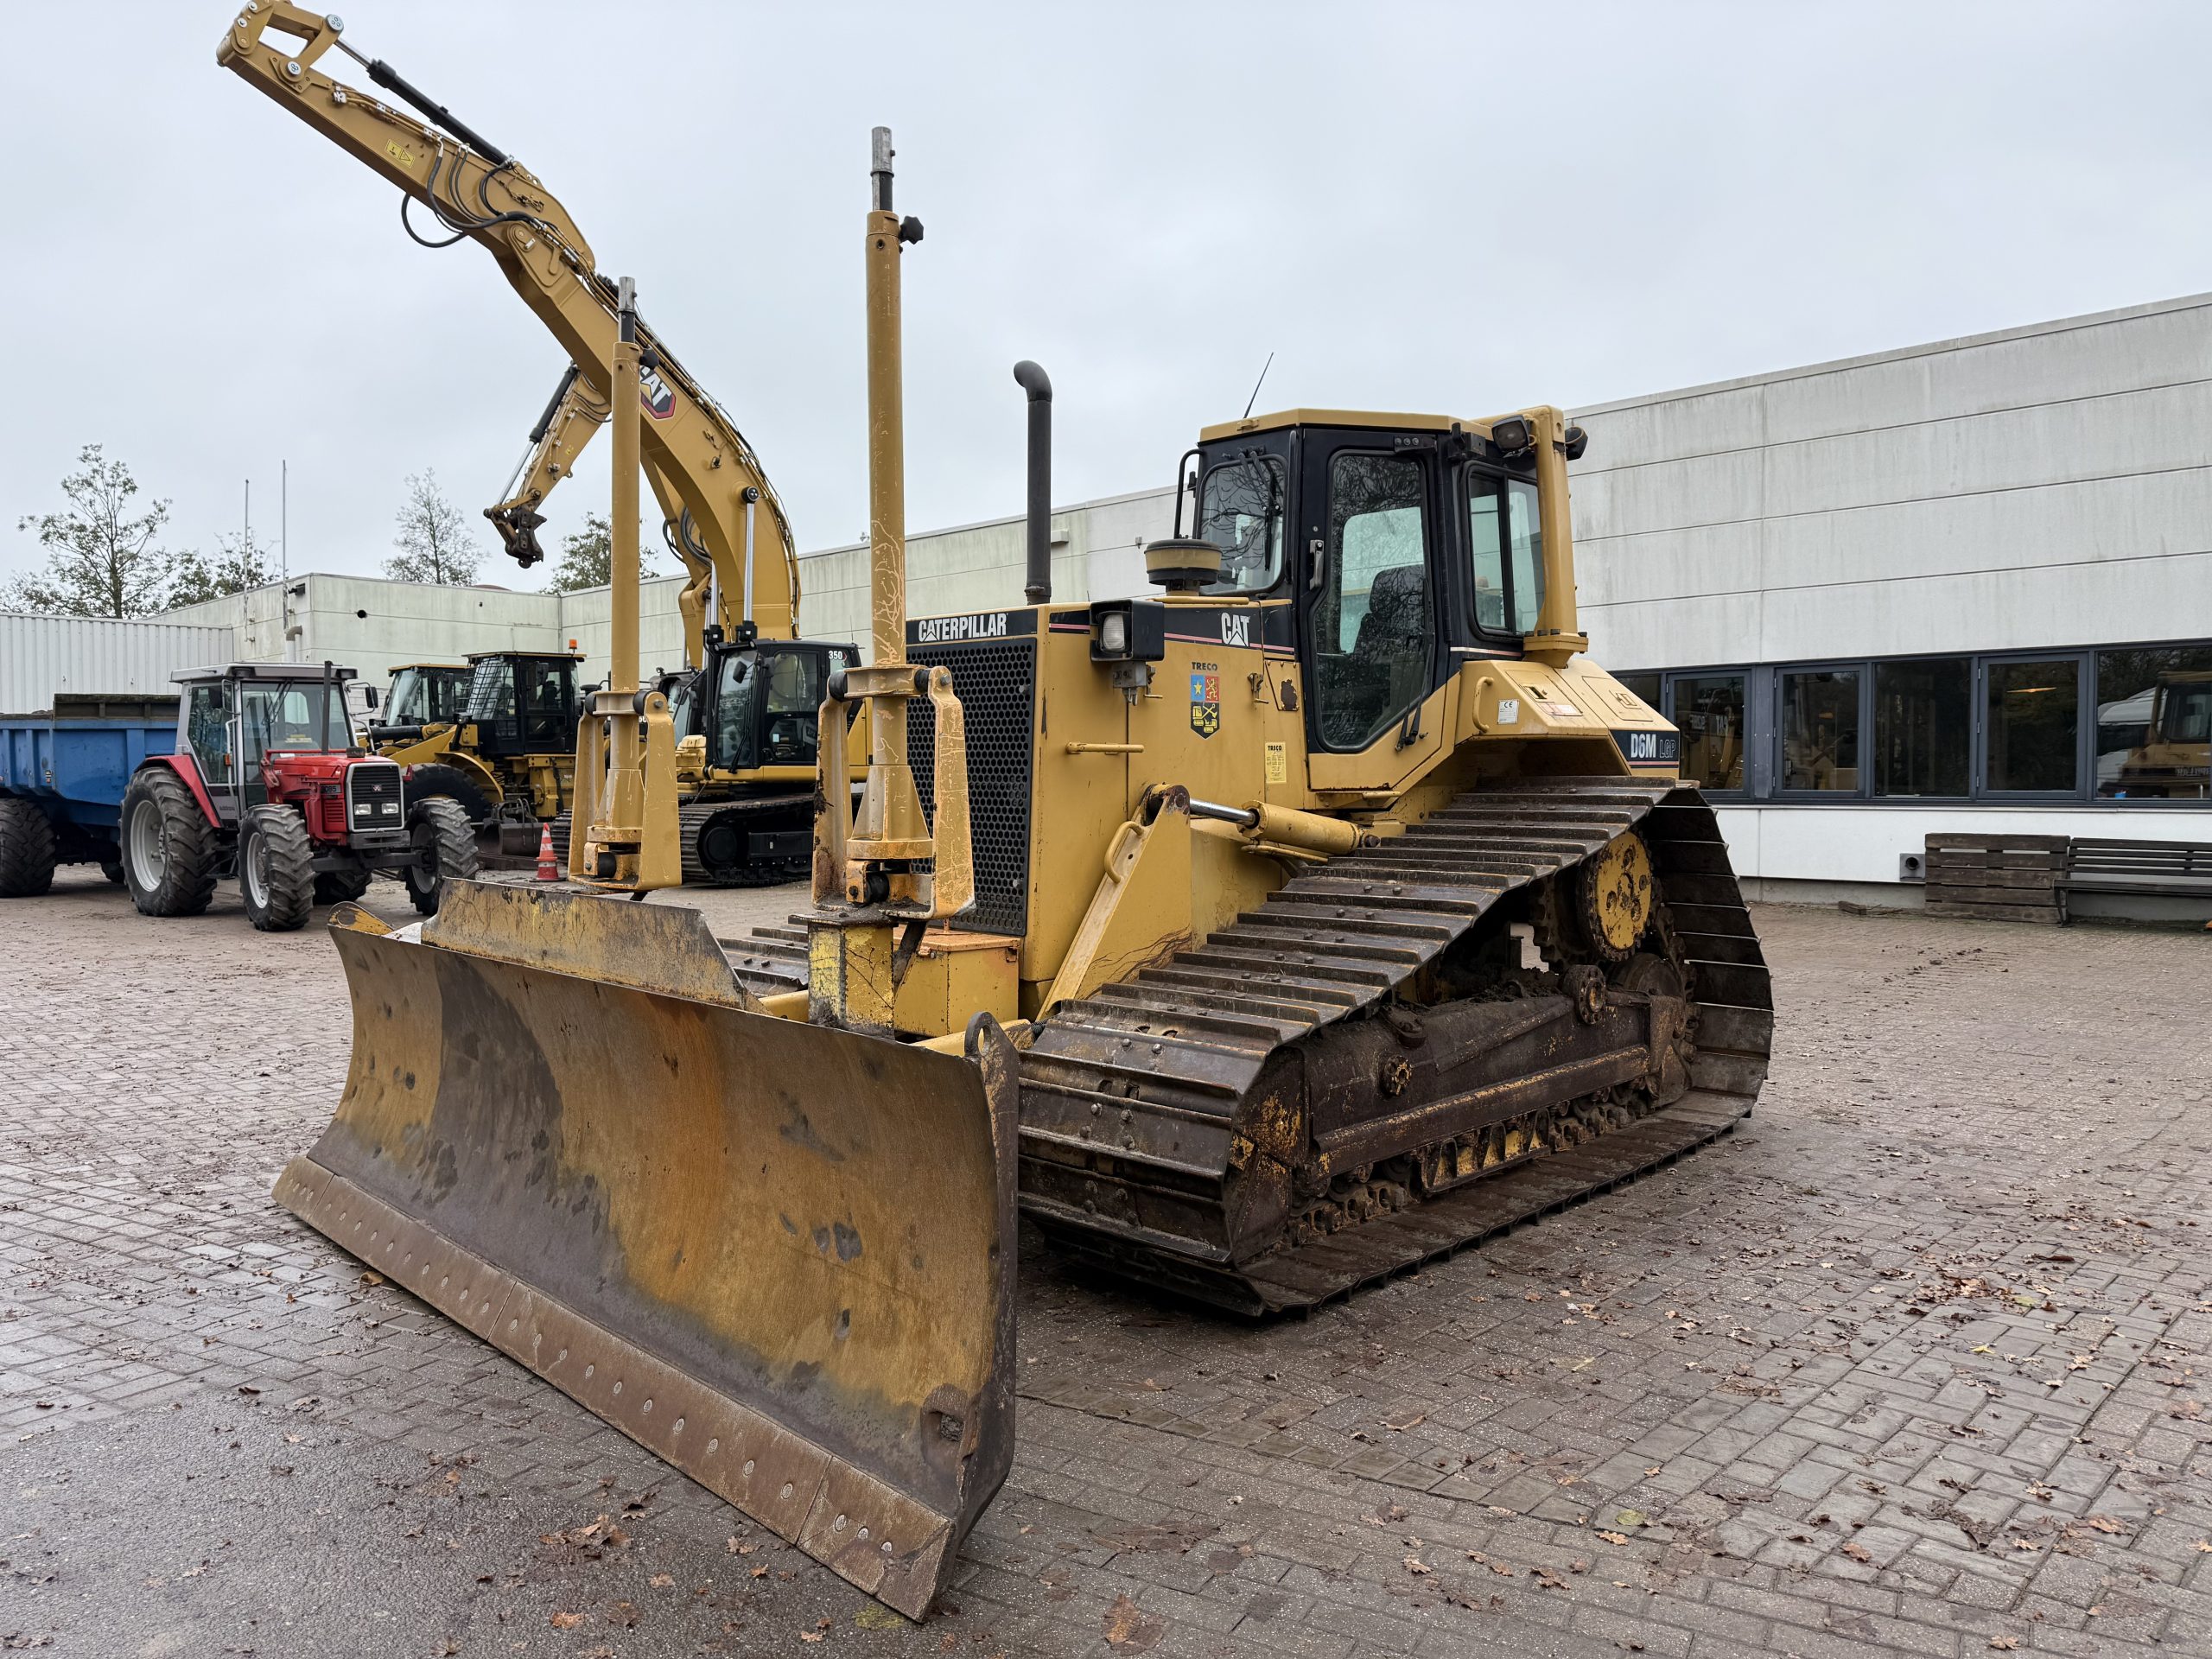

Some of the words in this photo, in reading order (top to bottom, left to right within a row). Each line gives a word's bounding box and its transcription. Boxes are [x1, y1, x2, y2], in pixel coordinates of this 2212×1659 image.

[918, 613, 1007, 642] CATERPILLAR
[1221, 612, 1249, 647] CAT
[828, 650, 842, 660] 350
[1192, 661, 1218, 671] TRECO
[1630, 734, 1656, 759] D6M
[1659, 739, 1676, 759] LGP
